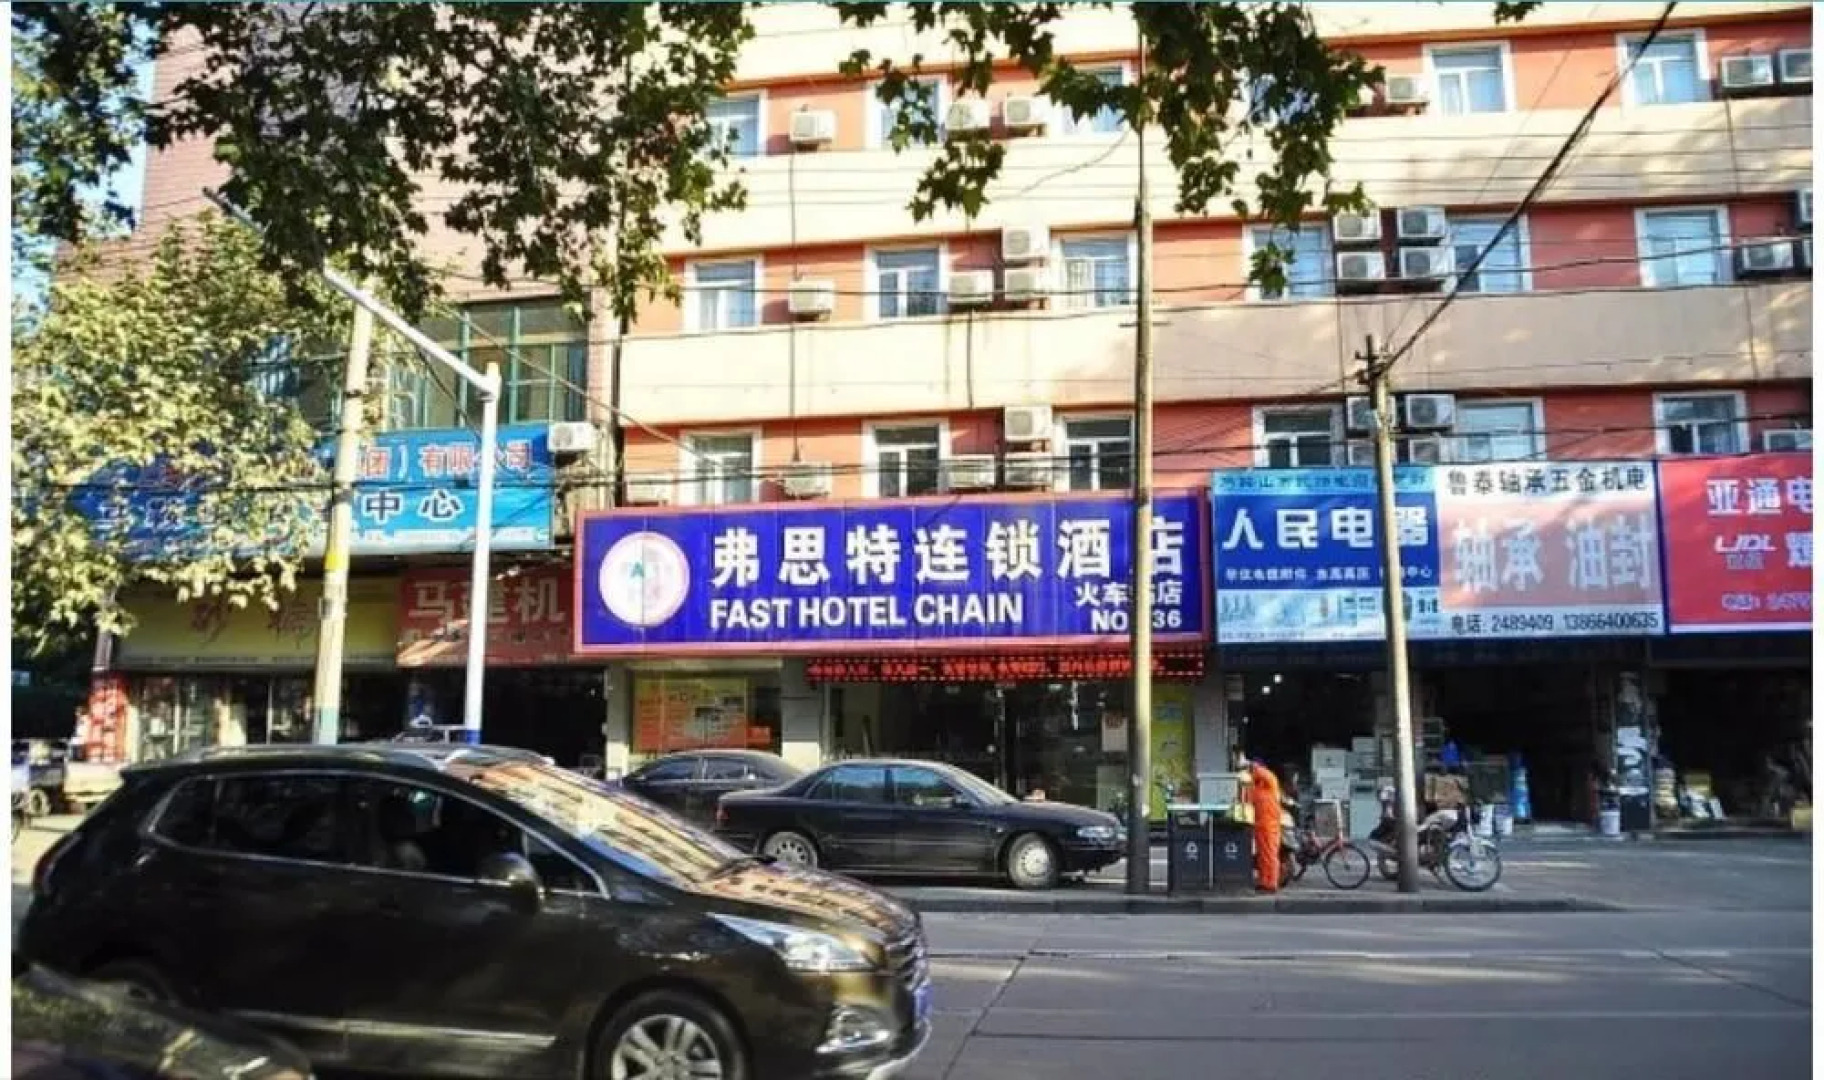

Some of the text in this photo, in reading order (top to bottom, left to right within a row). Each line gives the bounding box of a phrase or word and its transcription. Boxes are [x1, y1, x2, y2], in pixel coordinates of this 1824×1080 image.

[1449, 466, 1645, 495] 鲁泰轴承五金机电
[1222, 506, 1429, 549] 人民电器
[712, 517, 1183, 588] 弗思特连锁酒店
[1075, 580, 1182, 607] 火车店
[710, 593, 1023, 630] FAST HOTEL CHAIN
[1491, 614, 1553, 632] 2489409
